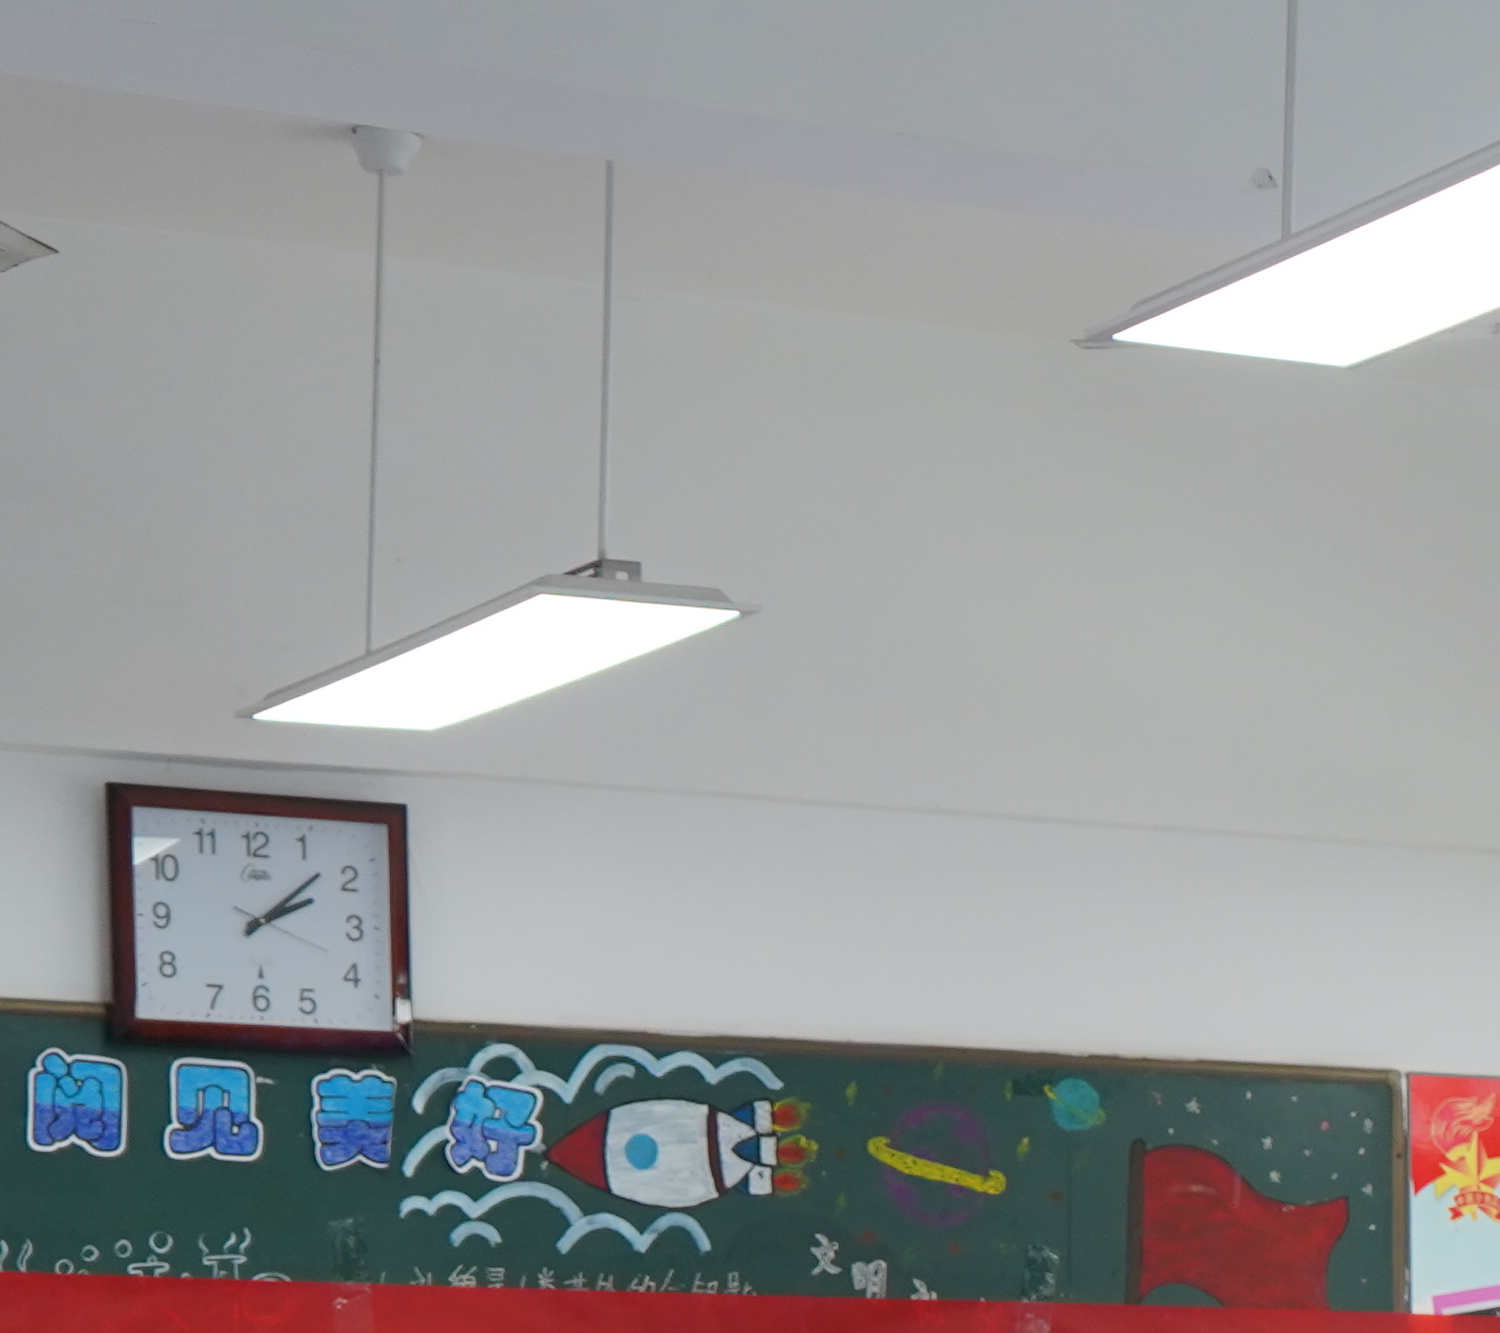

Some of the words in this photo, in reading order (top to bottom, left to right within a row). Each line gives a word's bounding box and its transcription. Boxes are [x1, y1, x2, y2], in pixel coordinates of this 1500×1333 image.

[192, 828, 217, 855] 11
[240, 831, 271, 859] 12
[296, 834, 308, 860] 1
[151, 854, 179, 882] 10
[340, 865, 359, 893] 2
[152, 901, 171, 929] 9
[345, 914, 364, 942] 3
[159, 950, 177, 979] 8
[342, 963, 361, 989] 4
[205, 983, 224, 1010] 7
[252, 985, 271, 1013] 6
[298, 988, 317, 1015] 5
